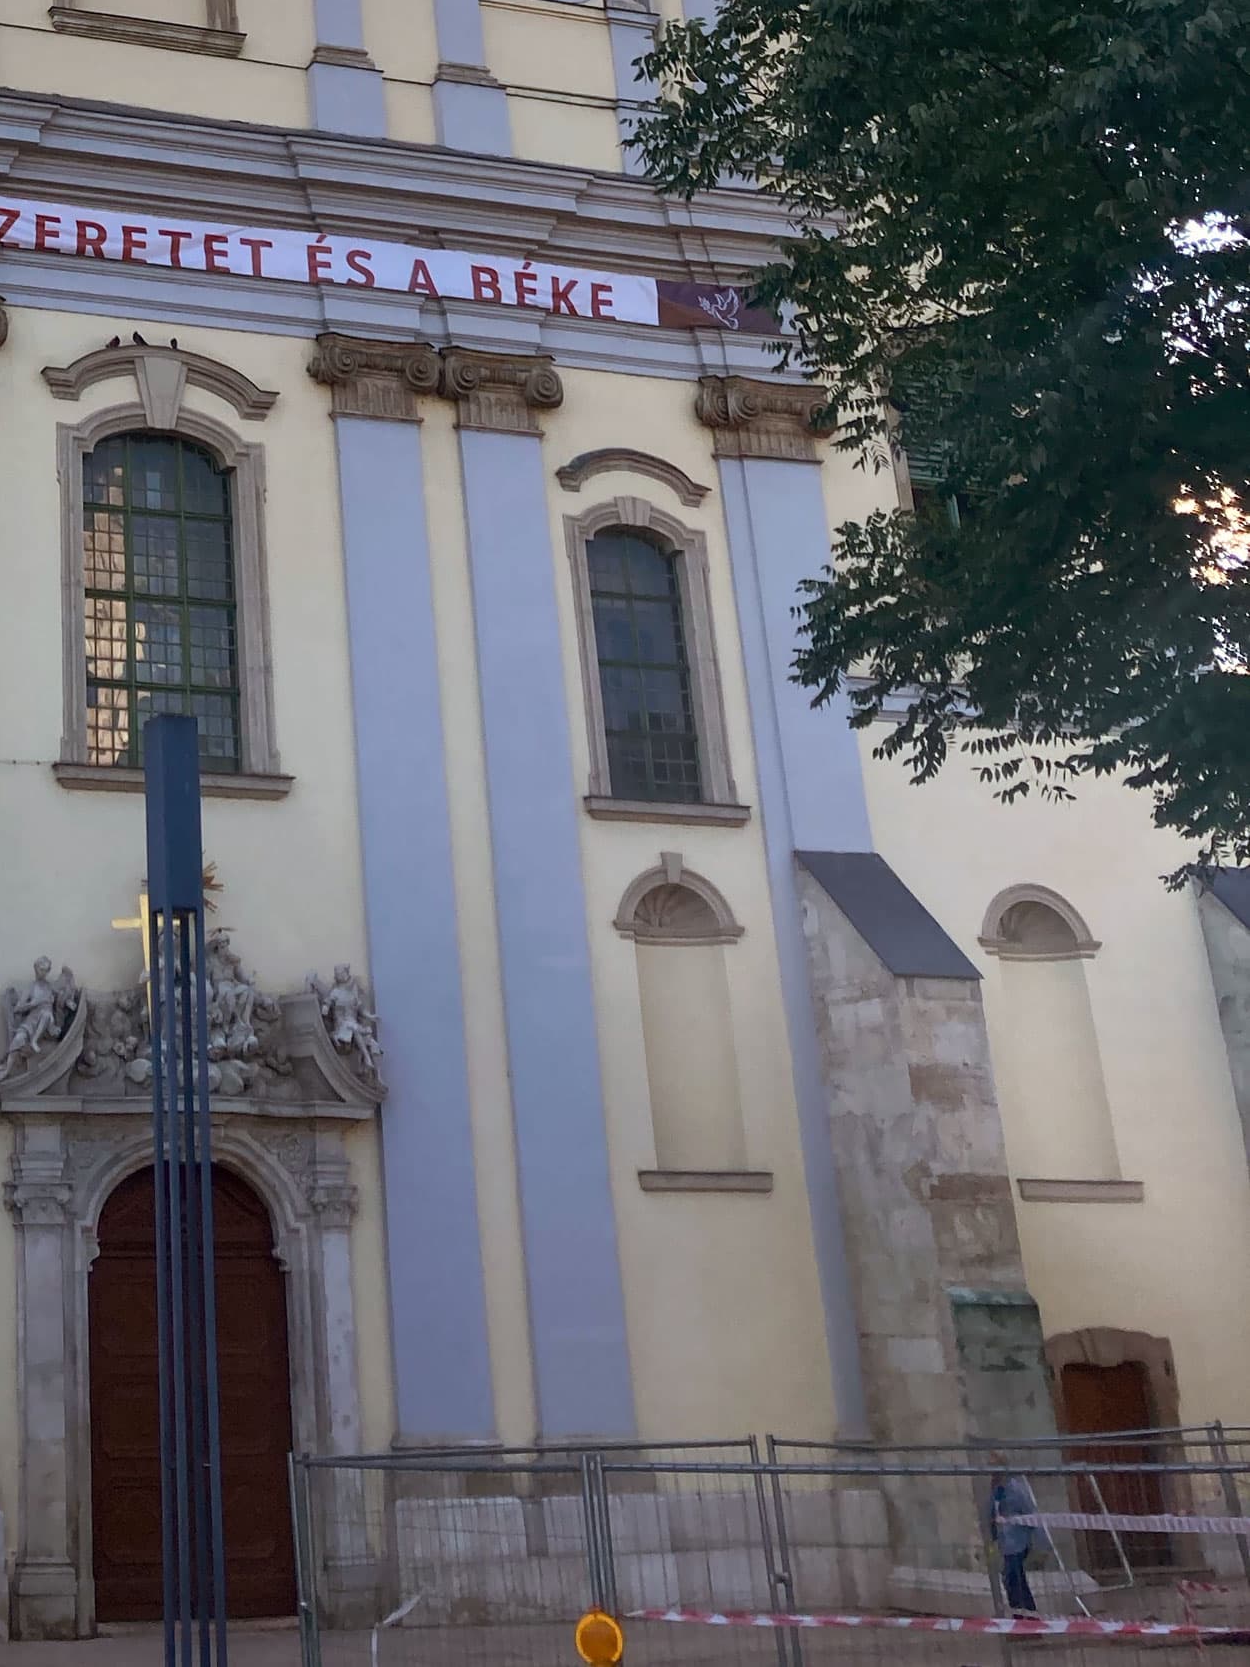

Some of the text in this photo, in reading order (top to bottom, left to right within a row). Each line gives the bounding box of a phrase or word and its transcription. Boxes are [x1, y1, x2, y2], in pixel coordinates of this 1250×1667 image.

[307, 234, 377, 289] ÉS
[408, 259, 440, 298] A
[471, 261, 617, 321] BÉKE
